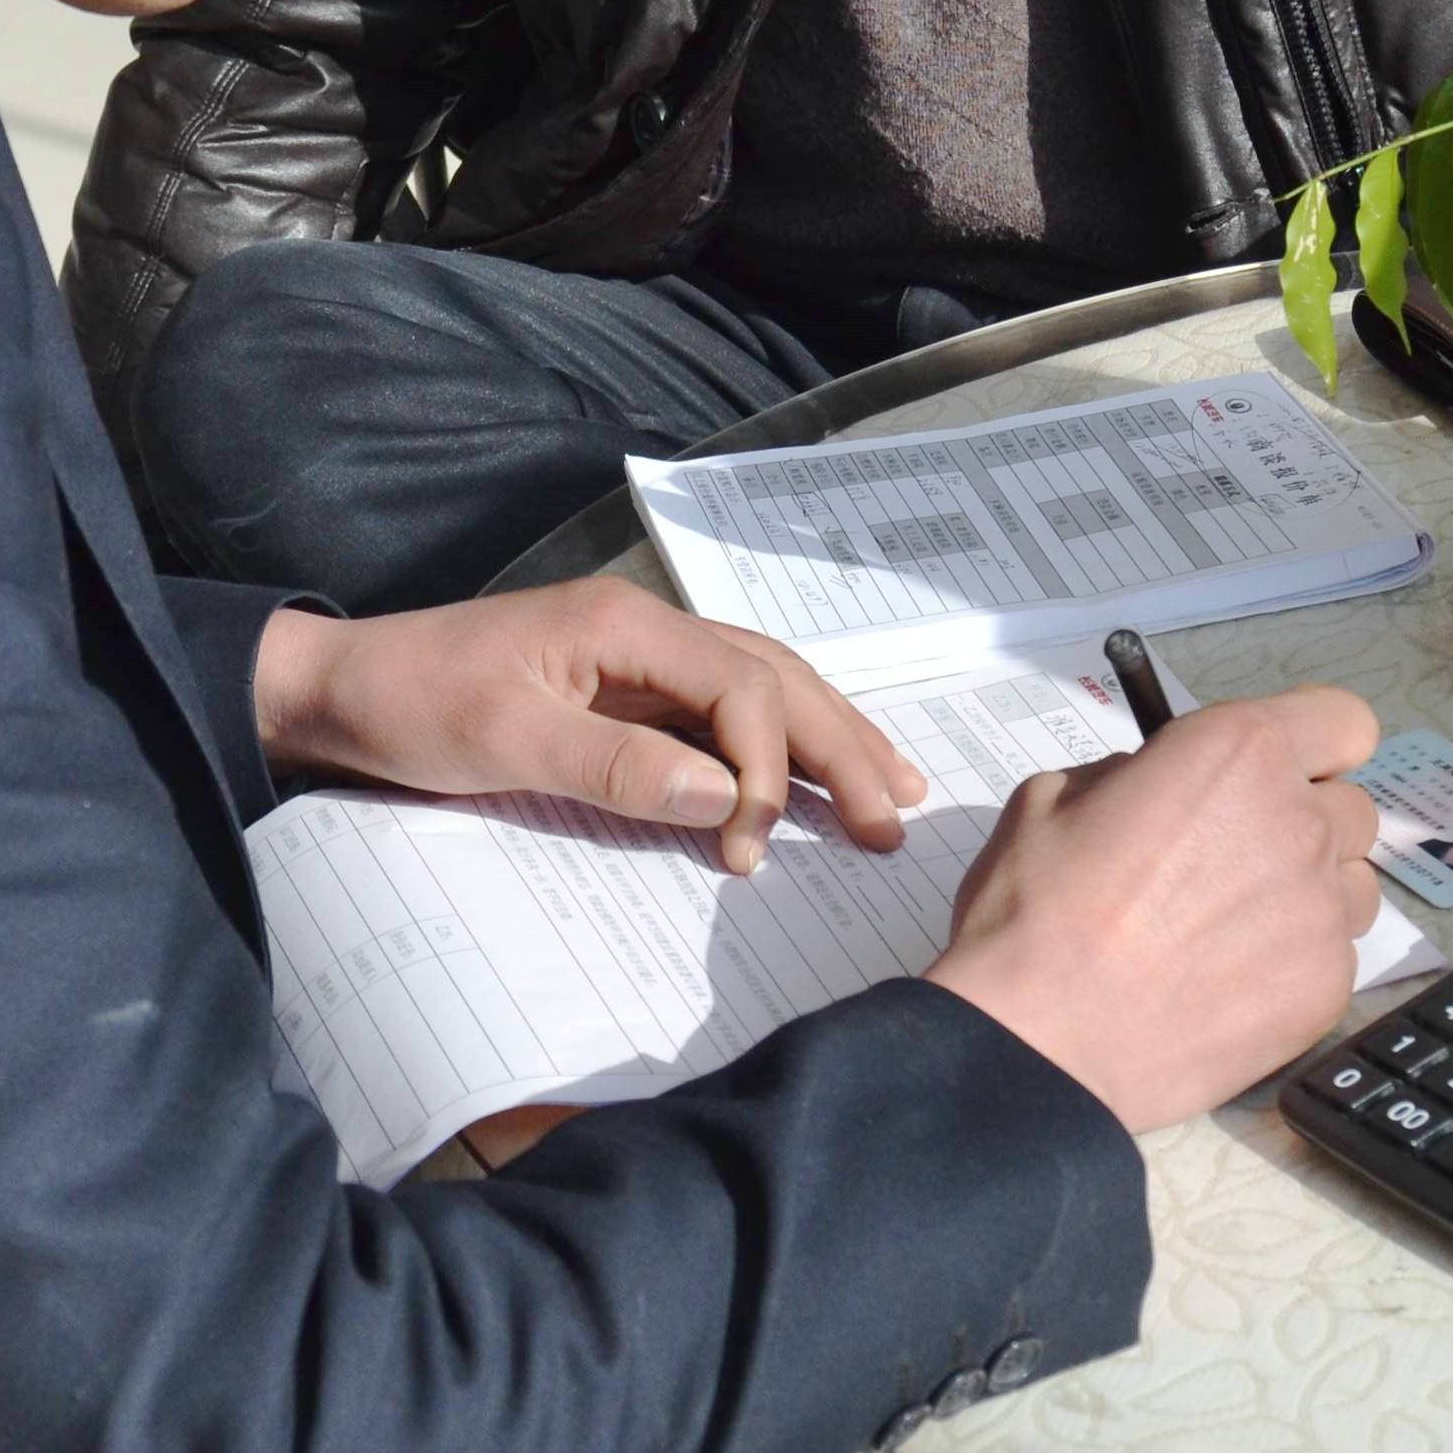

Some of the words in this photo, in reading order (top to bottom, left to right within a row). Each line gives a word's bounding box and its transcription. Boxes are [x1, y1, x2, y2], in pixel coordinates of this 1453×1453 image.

[1391, 1035, 1416, 1053] 1
[1333, 1068, 1362, 1089] 0
[1386, 1100, 1430, 1130] 00
